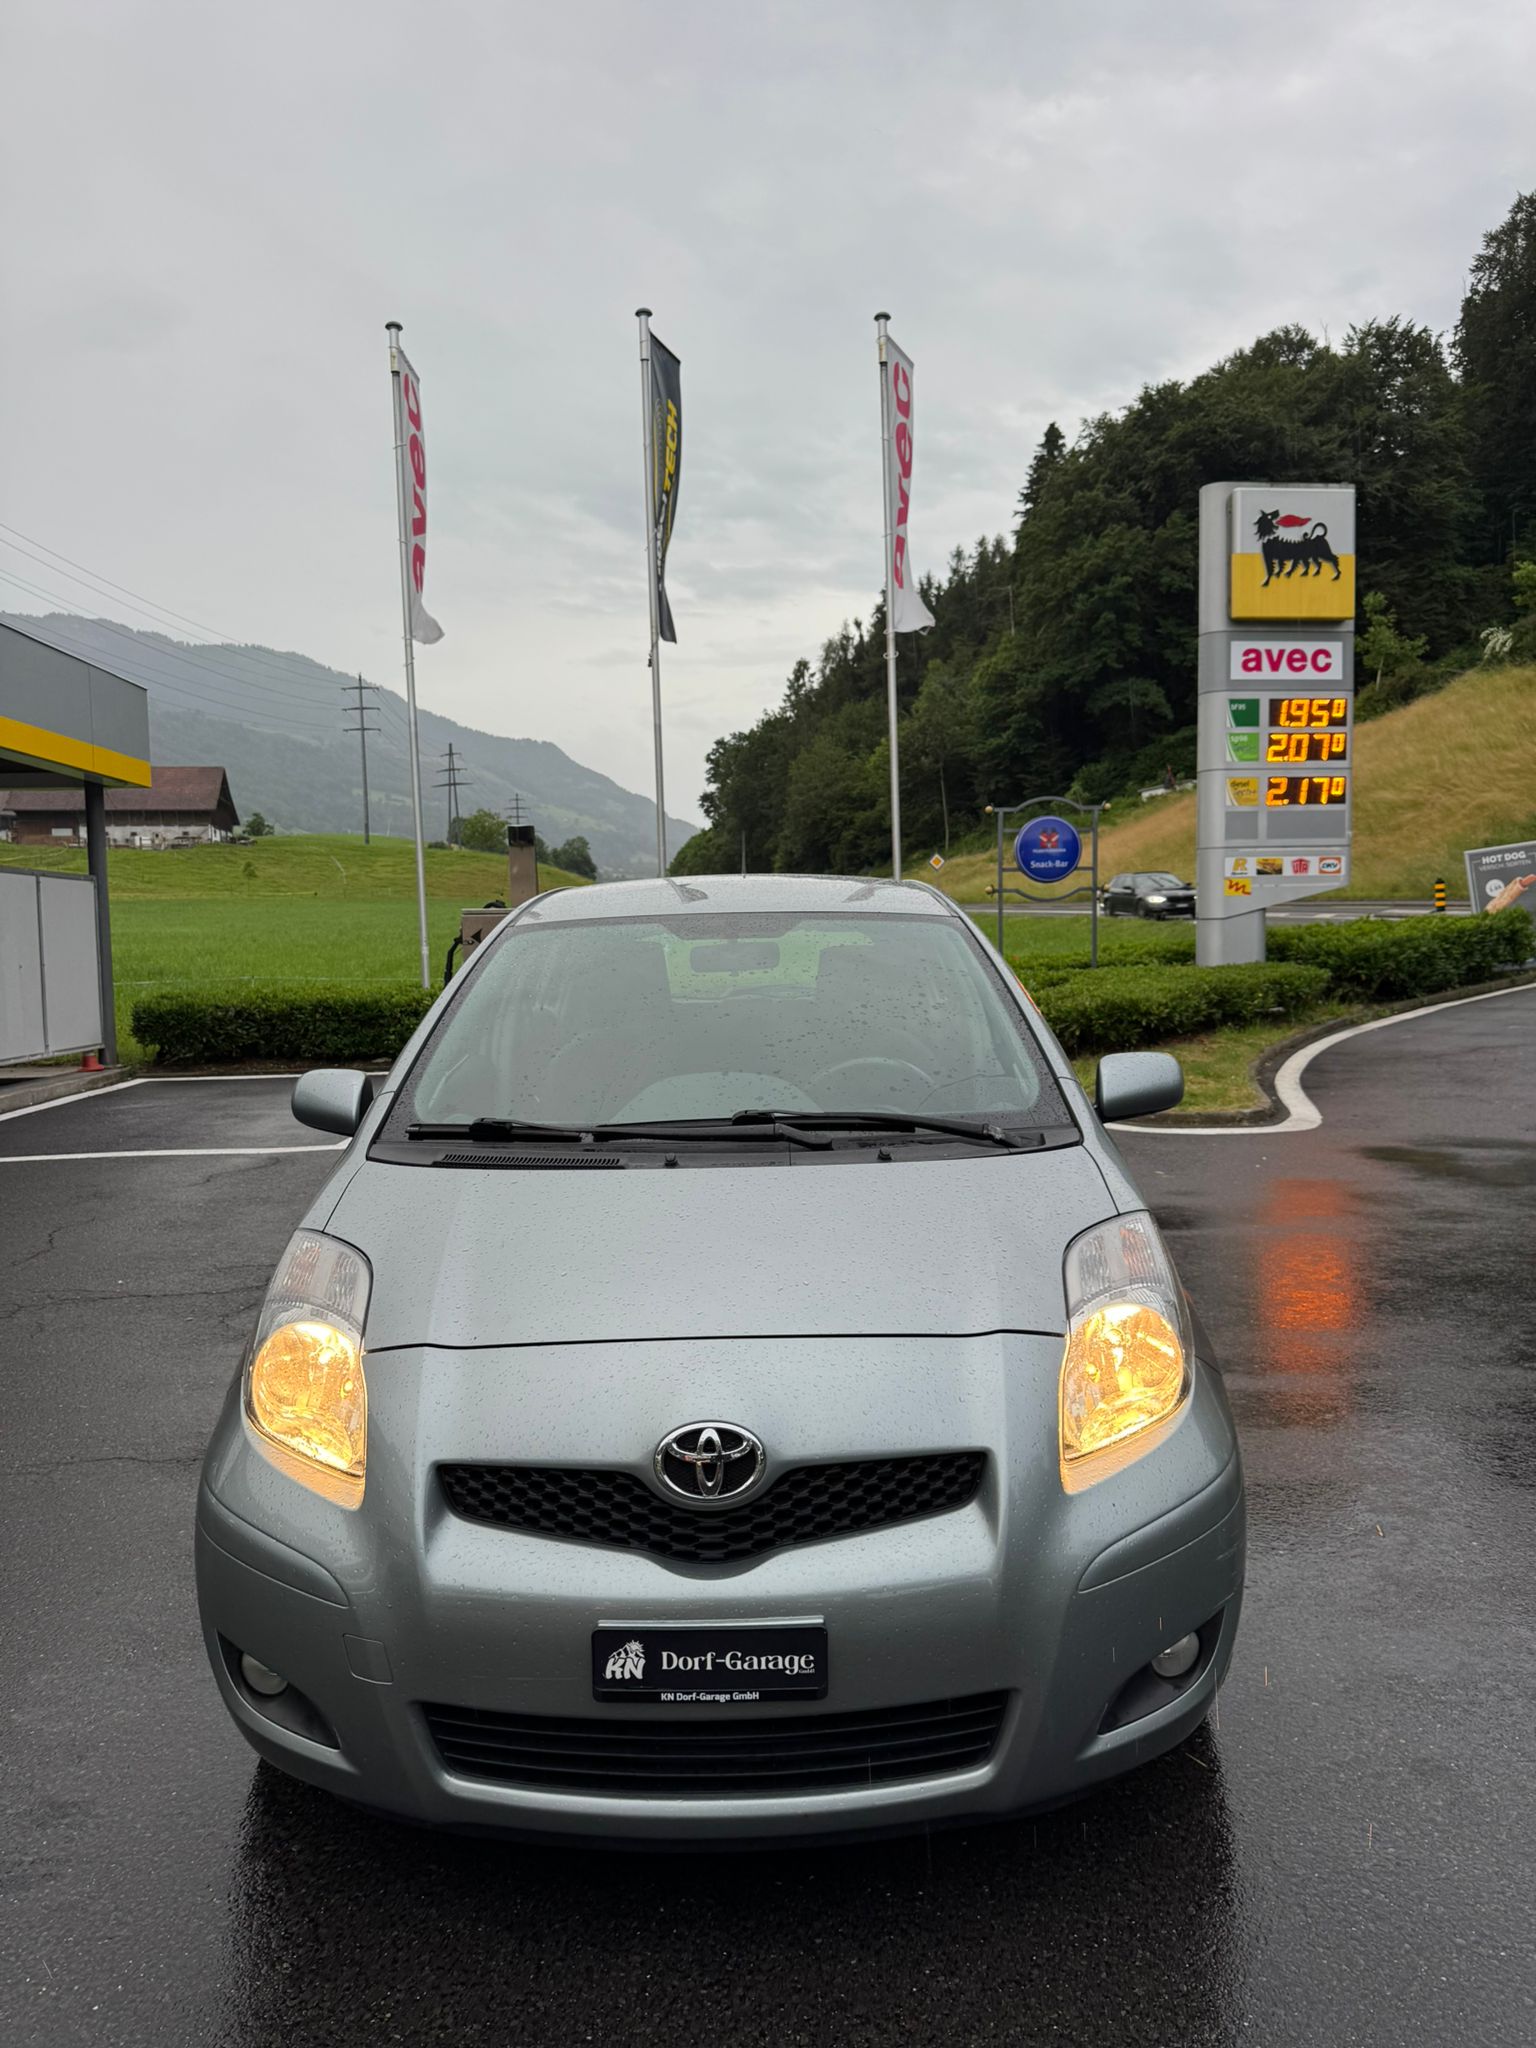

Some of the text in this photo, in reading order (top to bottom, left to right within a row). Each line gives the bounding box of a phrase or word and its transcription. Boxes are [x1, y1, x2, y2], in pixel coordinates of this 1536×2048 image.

[403, 373, 427, 594] avec
[893, 361, 912, 590] avec
[1241, 647, 1333, 673] avec
[1030, 859, 1069, 869] Snack-Bar
[1481, 851, 1526, 864] HOT DOG
[661, 1651, 815, 1675] Dorf-Garage
[660, 1691, 760, 1702] KN Dorf-Garage GmbH
